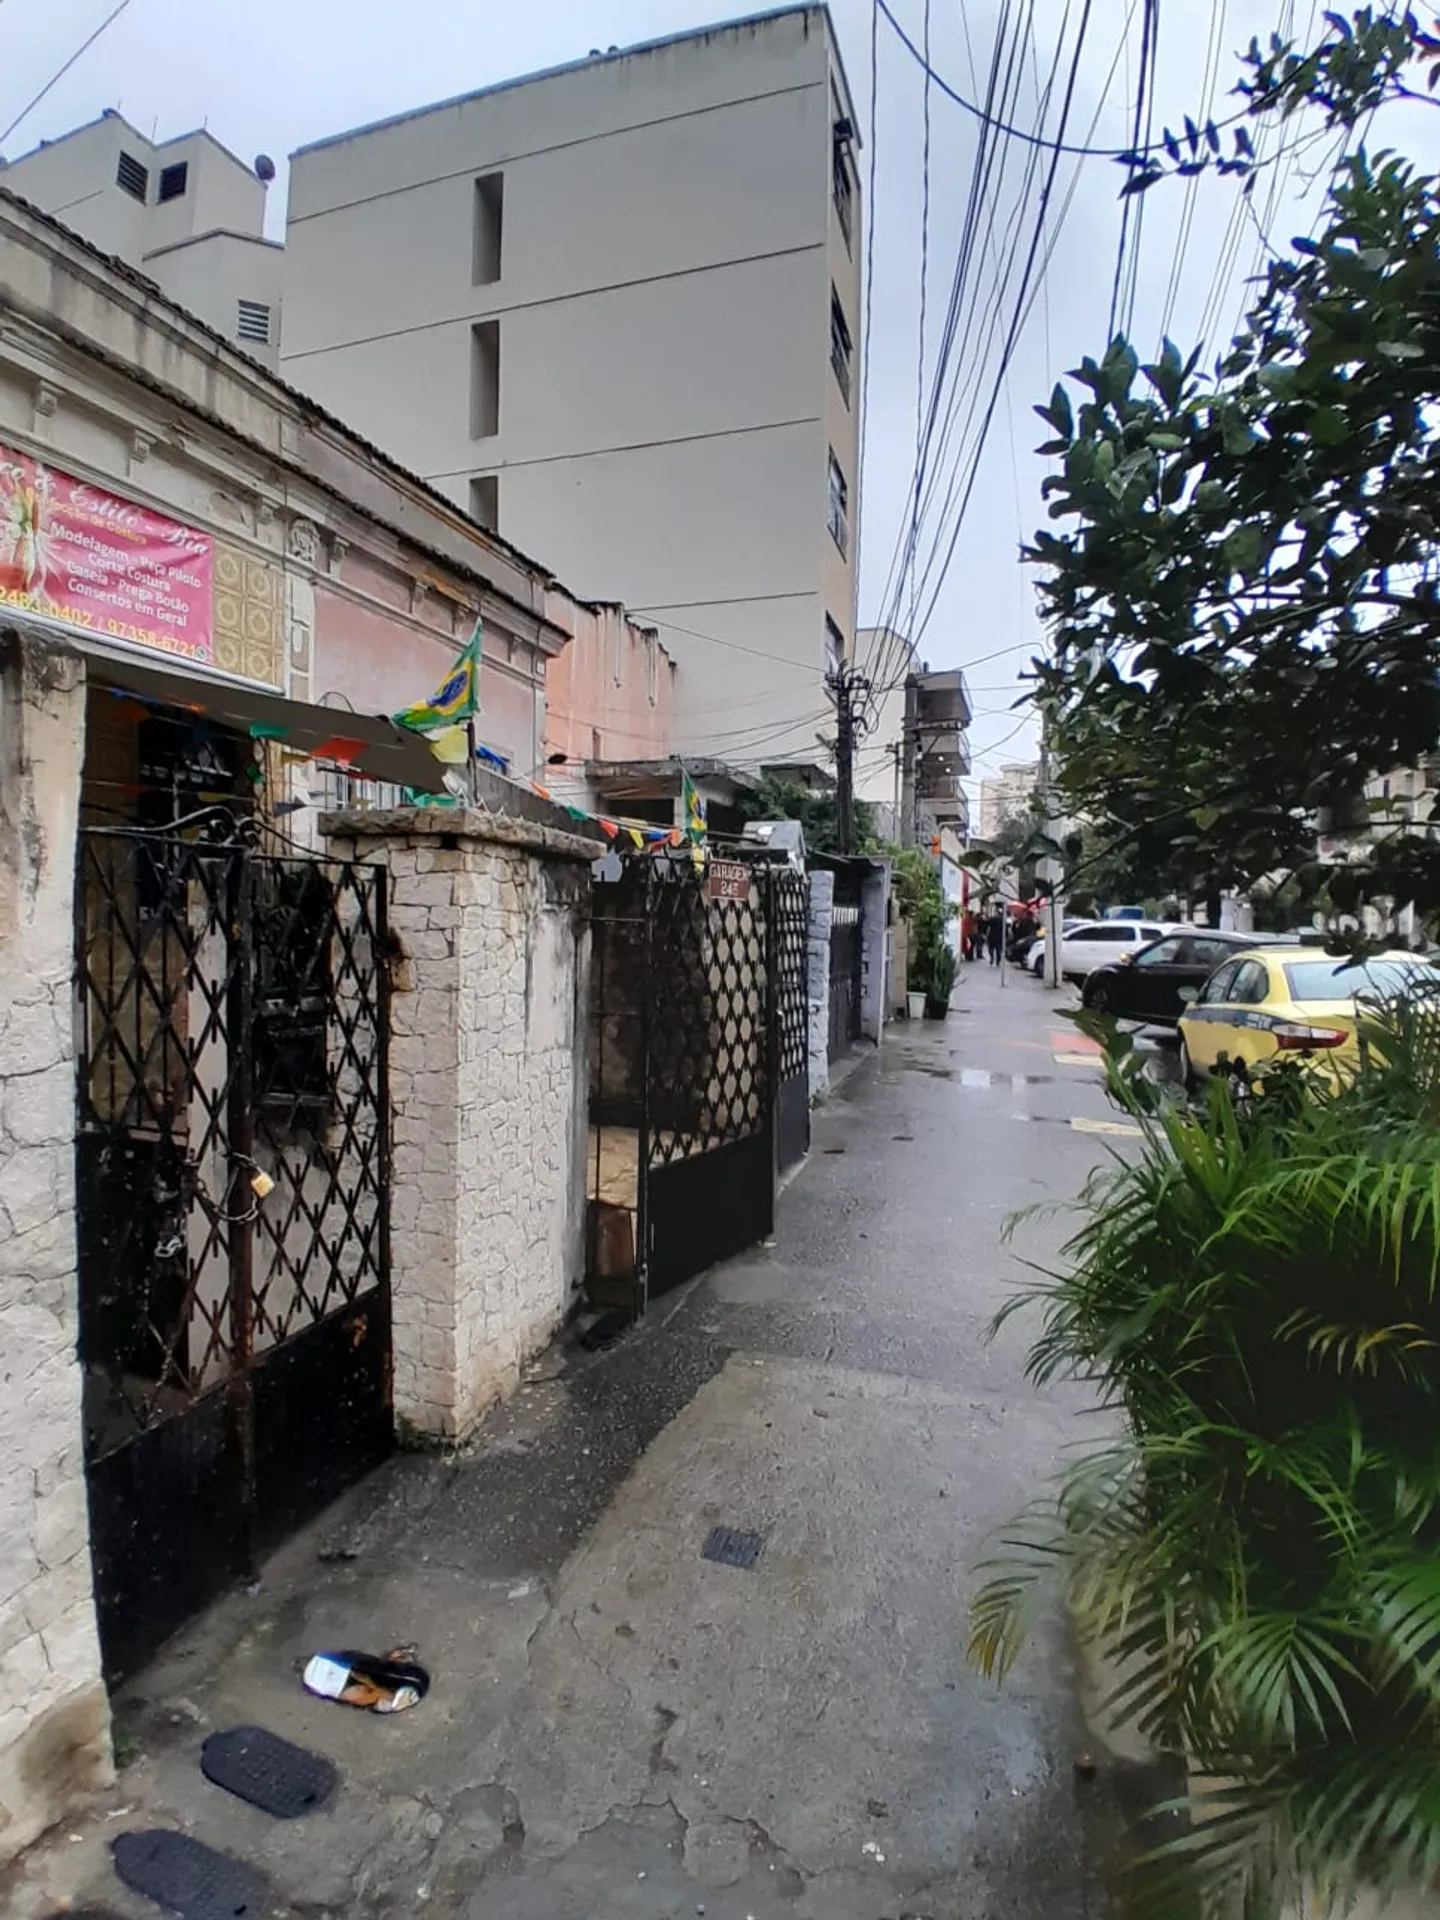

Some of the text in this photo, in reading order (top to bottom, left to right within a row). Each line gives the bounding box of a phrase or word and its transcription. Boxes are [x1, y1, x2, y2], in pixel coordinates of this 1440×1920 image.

[69, 484, 138, 527] Estilo
[160, 524, 209, 554] Bia
[50, 521, 129, 561] Modelagem
[168, 566, 202, 588] Piloto
[88, 553, 171, 592] Corte Costura
[68, 578, 188, 628] Consertos em Geral
[155, 594, 190, 614] Botão
